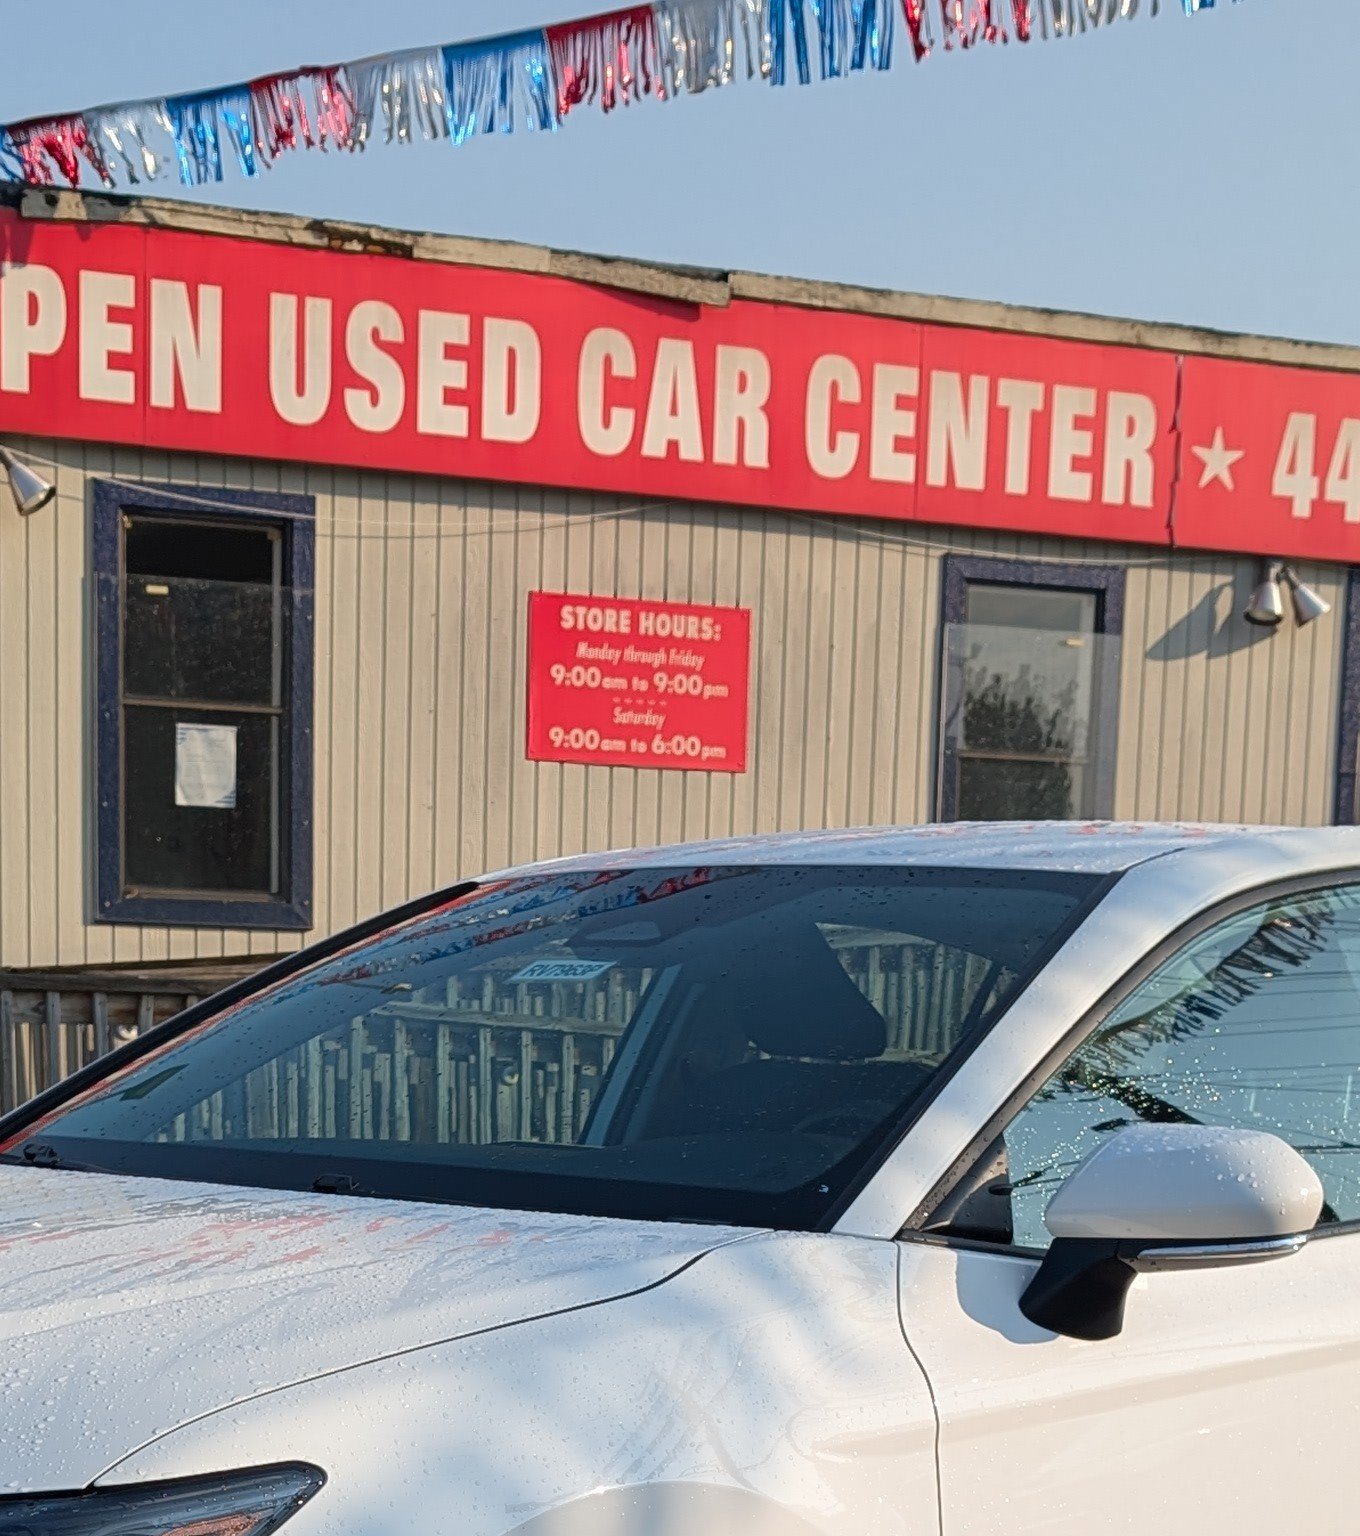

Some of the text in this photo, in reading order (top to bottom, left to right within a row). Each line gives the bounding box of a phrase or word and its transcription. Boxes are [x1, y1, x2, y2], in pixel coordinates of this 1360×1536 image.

[268, 292, 543, 444] USED
[577, 327, 772, 470] CAR
[804, 354, 1157, 509] CENTER
[560, 604, 722, 642] STORE HOURS:
[576, 641, 705, 671] Monday through Friday
[550, 663, 730, 700] 9:00am to 9:00pm
[612, 706, 667, 730] Saturday
[548, 726, 727, 761] 9:00am to 6:00pm
